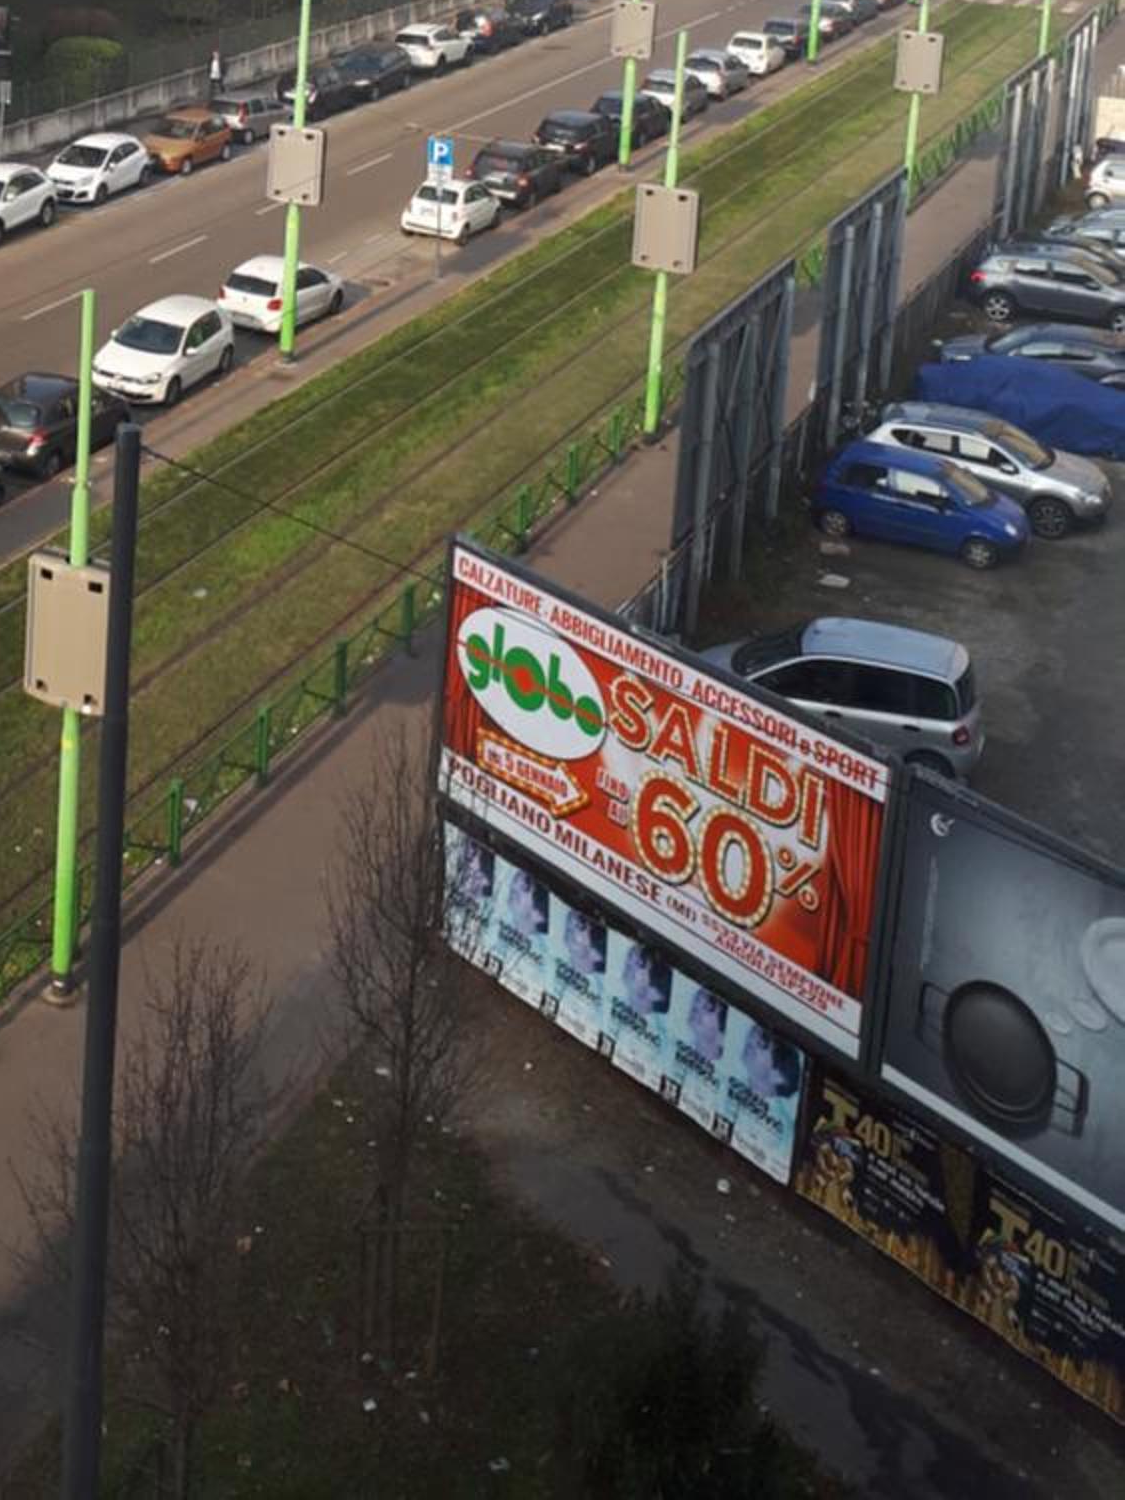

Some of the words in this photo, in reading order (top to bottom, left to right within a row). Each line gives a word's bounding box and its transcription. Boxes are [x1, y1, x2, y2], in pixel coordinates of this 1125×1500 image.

[433, 140, 448, 161] P
[458, 555, 540, 615] CALZATURE
[549, 602, 683, 691] ABBIGLIAMENTO
[692, 676, 796, 749] ACCESSORI
[812, 738, 878, 792] SPORT
[464, 624, 604, 736] globo
[448, 754, 550, 836] POGLIANO
[555, 821, 661, 905] MILANESE
[608, 674, 826, 848] SALDI
